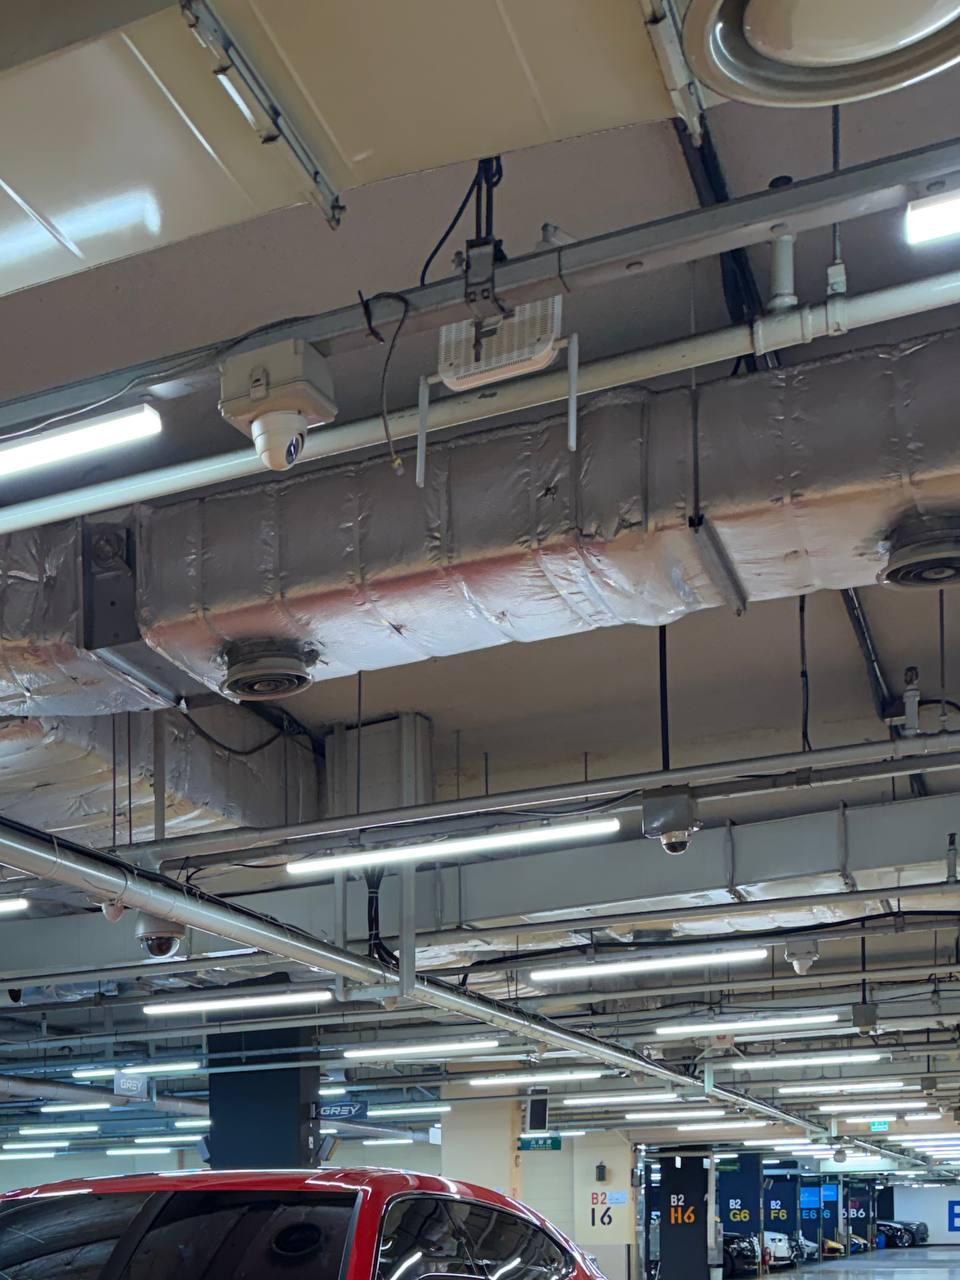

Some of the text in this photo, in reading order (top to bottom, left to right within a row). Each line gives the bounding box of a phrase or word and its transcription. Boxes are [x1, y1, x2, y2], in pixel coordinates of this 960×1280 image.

[120, 1079, 142, 1091] GREY
[320, 1104, 360, 1116] GREY
[591, 1192, 607, 1206] B2
[670, 1194, 685, 1206] B2
[729, 1199, 741, 1209] B2
[770, 1200, 781, 1209] B2
[670, 1206, 695, 1225] H6
[729, 1209, 750, 1222] G6
[770, 1209, 788, 1220] F6
[802, 1209, 817, 1219] E6
[850, 1208, 866, 1218] B6
